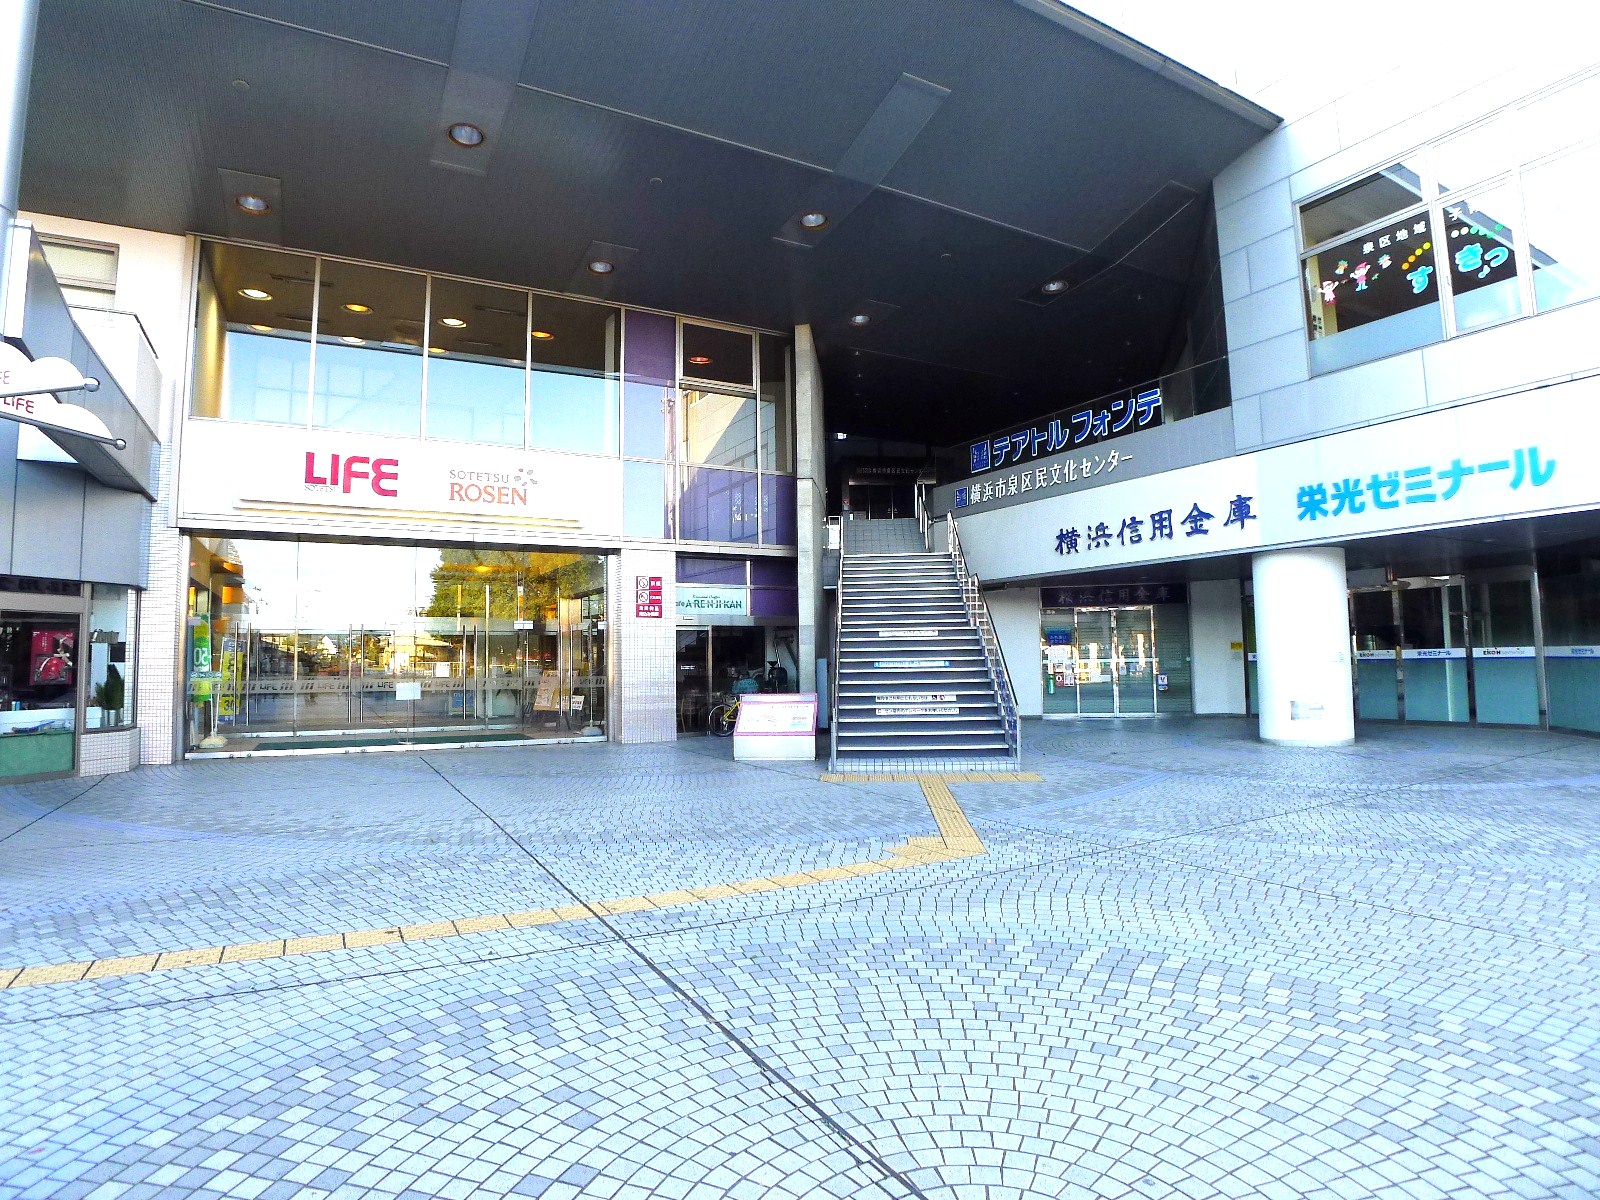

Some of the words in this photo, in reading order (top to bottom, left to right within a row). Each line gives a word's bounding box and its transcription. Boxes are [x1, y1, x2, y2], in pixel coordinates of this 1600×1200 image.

[993, 388, 1163, 466] テアトルフォンテ
[305, 451, 399, 497] LIFE
[449, 469, 511, 484] SOTETSU
[449, 482, 528, 505] ROSEN
[970, 450, 1133, 505] 横浜市泉区民文化センター
[1297, 446, 1557, 521] 栄光ゼミナール
[1055, 495, 1258, 555] 横浜信用金庫
